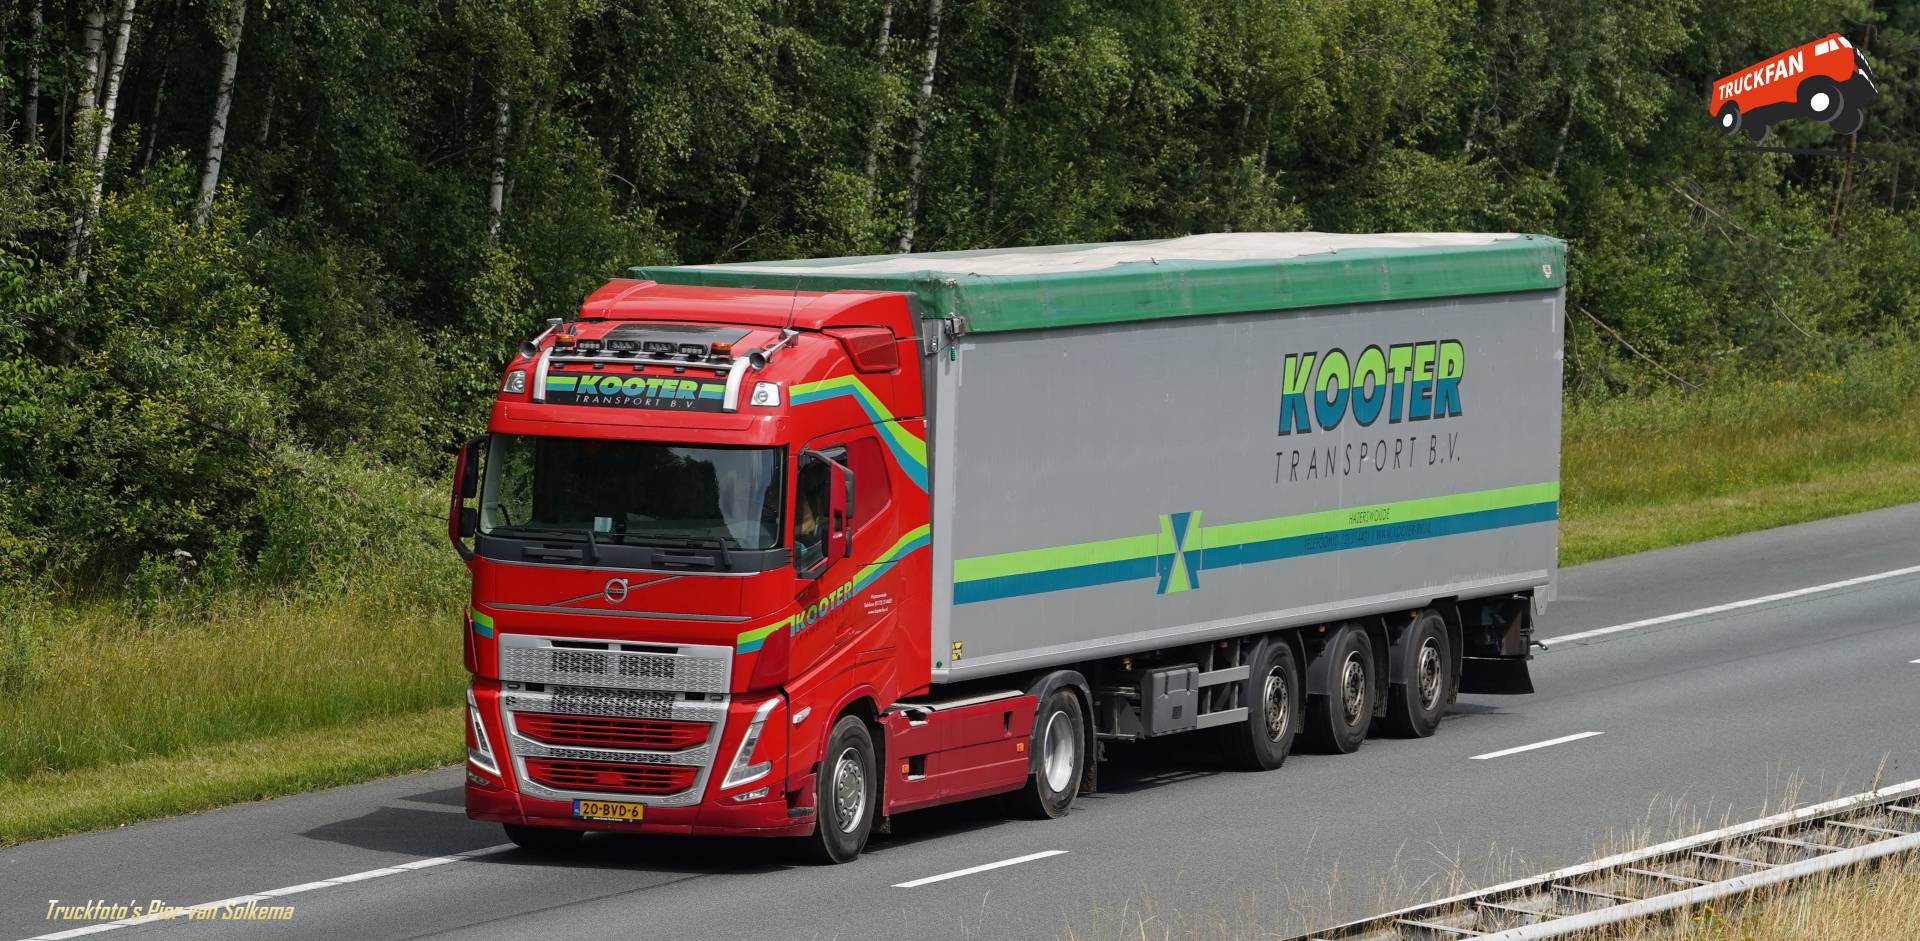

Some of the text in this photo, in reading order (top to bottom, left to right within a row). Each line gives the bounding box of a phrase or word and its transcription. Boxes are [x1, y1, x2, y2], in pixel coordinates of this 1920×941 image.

[575, 394, 660, 407] TRANSPORT
[577, 375, 698, 400] KOOTER
[1278, 338, 1464, 436] KOOTER
[1275, 431, 1461, 484] TRANSPORT B.V.
[795, 580, 853, 634] KOOTER
[583, 802, 639, 818] 20-BVD-6
